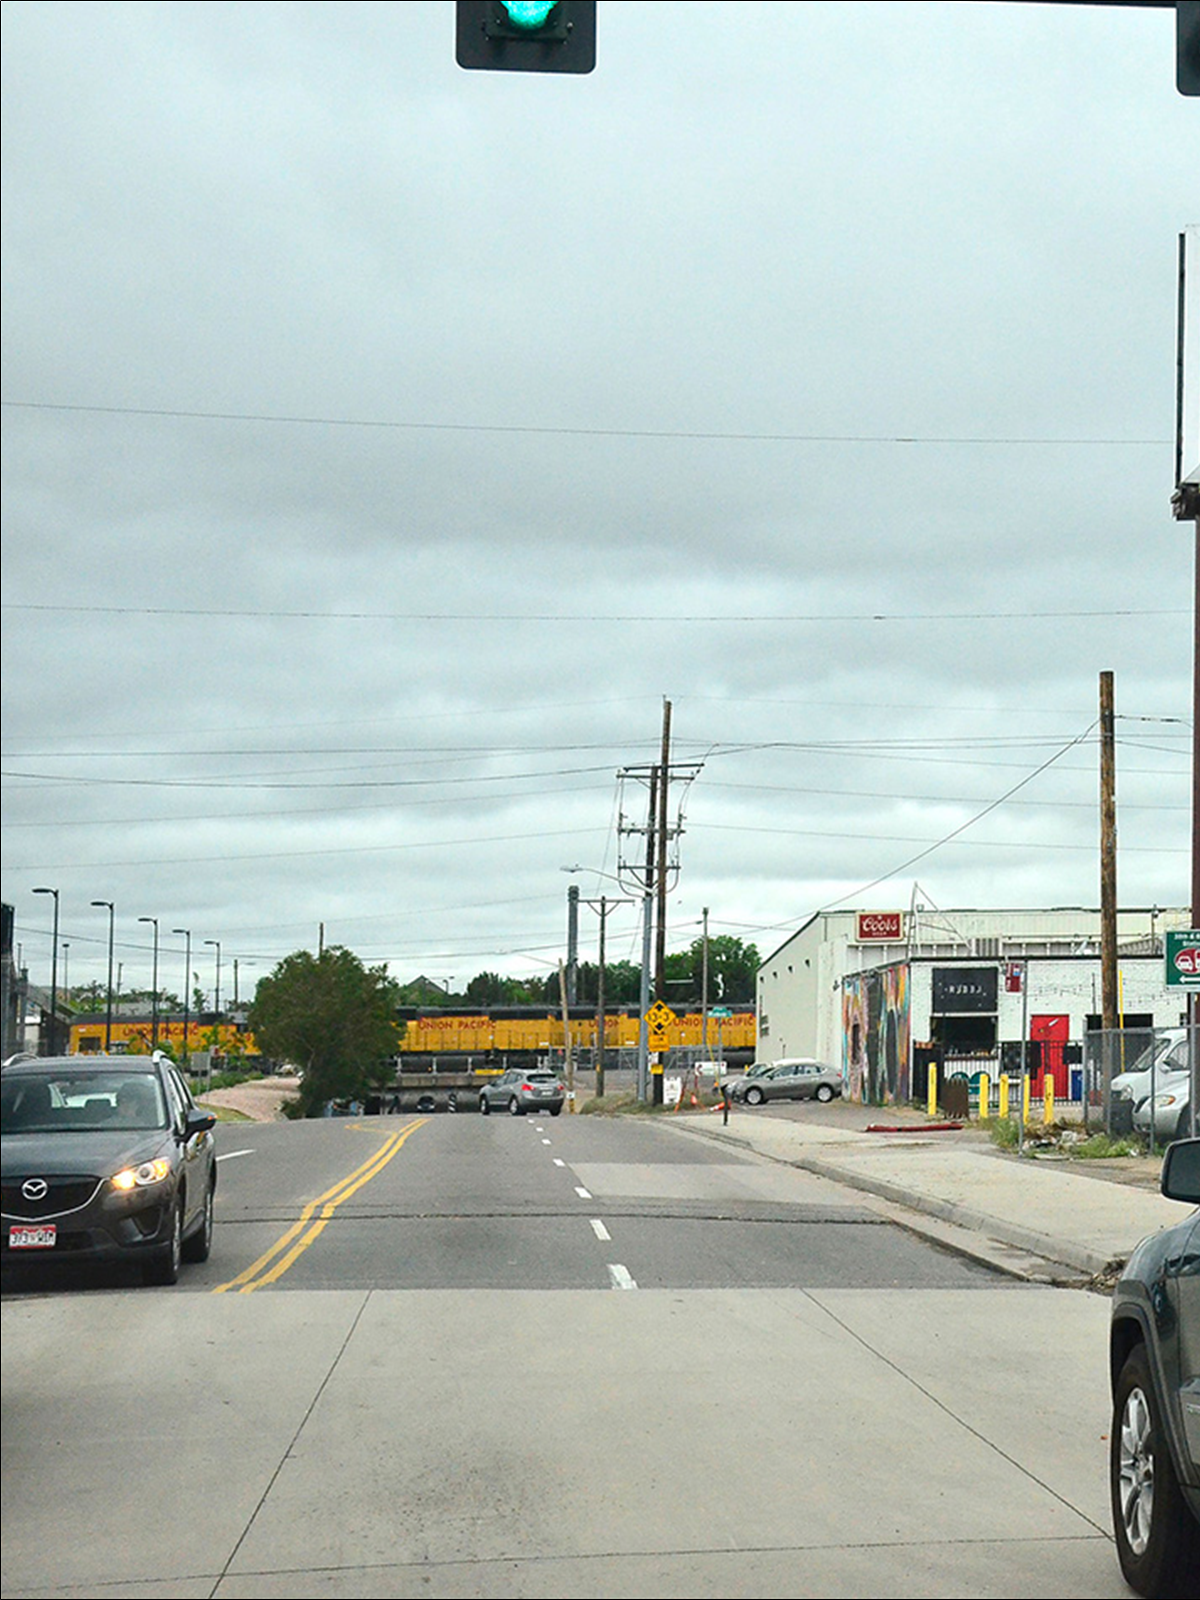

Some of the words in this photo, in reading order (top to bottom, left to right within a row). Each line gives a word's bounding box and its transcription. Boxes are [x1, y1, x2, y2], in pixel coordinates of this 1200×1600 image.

[862, 916, 898, 932] Coors
[419, 1020, 453, 1030] UNION
[458, 1020, 496, 1030] PACIFIC
